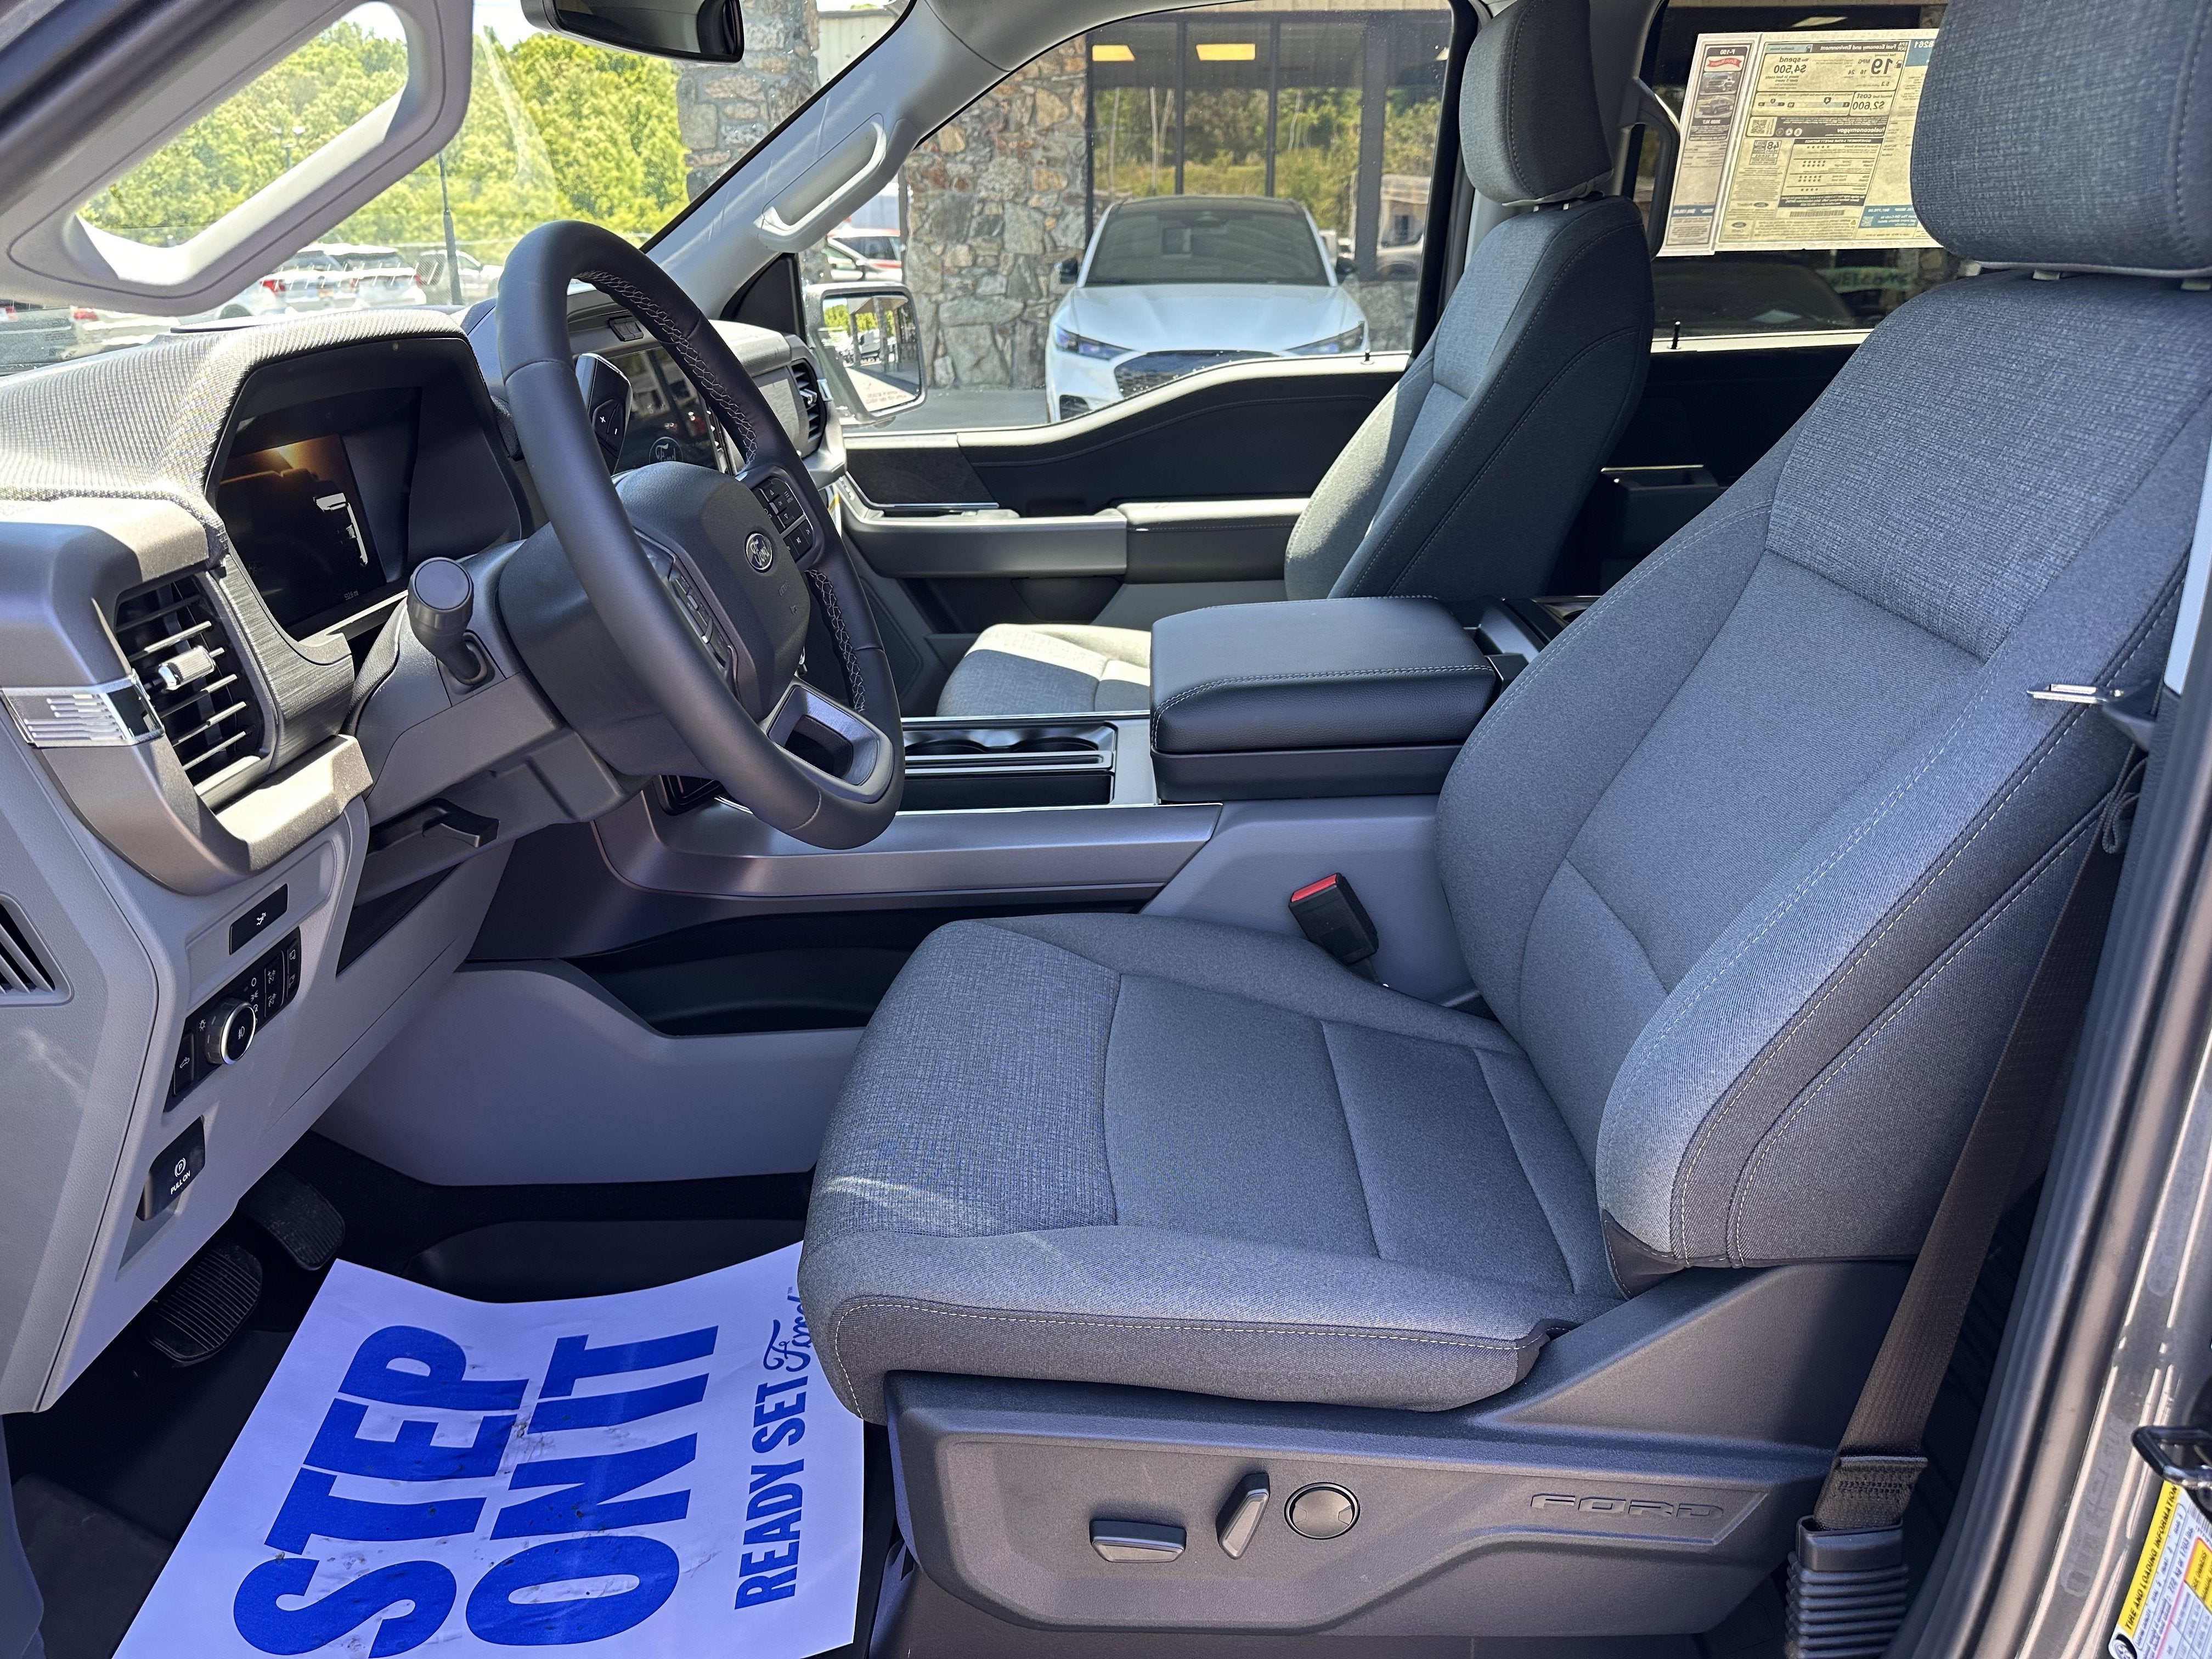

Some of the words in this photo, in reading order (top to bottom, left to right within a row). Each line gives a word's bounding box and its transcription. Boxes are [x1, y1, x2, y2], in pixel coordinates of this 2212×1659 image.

[171, 1180, 183, 1194] PULL
[183, 1170, 190, 1182] ON
[526, 1325, 719, 1435] IT
[752, 1375, 809, 1454] SET
[233, 1325, 530, 1659] STEP
[465, 1432, 698, 1646] ON
[735, 1458, 804, 1610] READY
[1531, 1493, 1724, 1519] FORD
[2125, 1609, 2136, 1629] TIRE
[2134, 1589, 2143, 1609] AND
[2140, 1549, 2158, 1589] LOADING
[2155, 1485, 2177, 1548] INFORMATION
[2174, 1567, 2182, 1578] kg
